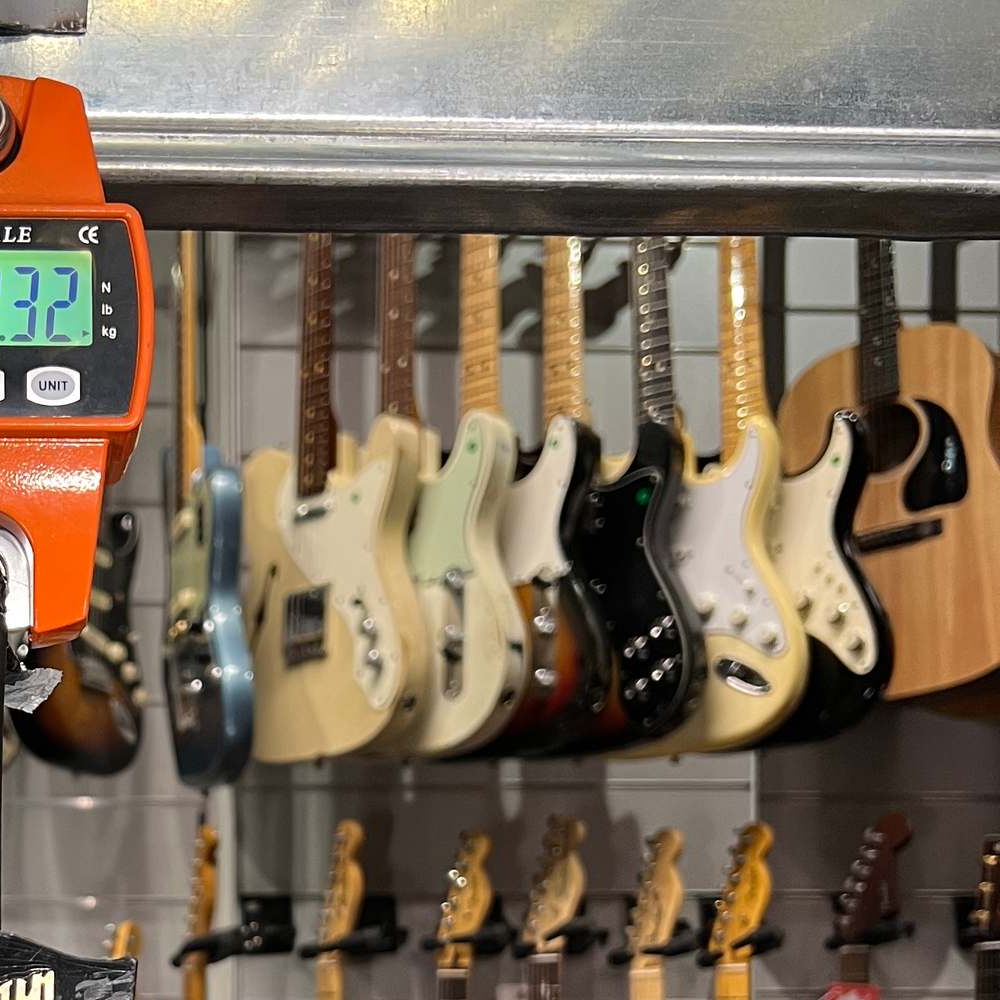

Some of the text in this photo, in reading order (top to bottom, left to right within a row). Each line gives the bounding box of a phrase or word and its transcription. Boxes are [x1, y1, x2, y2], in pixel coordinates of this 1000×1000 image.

[101, 282, 111, 293] N
[101, 304, 113, 316] lb
[101, 325, 117, 340] kg
[38, 380, 69, 393] UNIT
